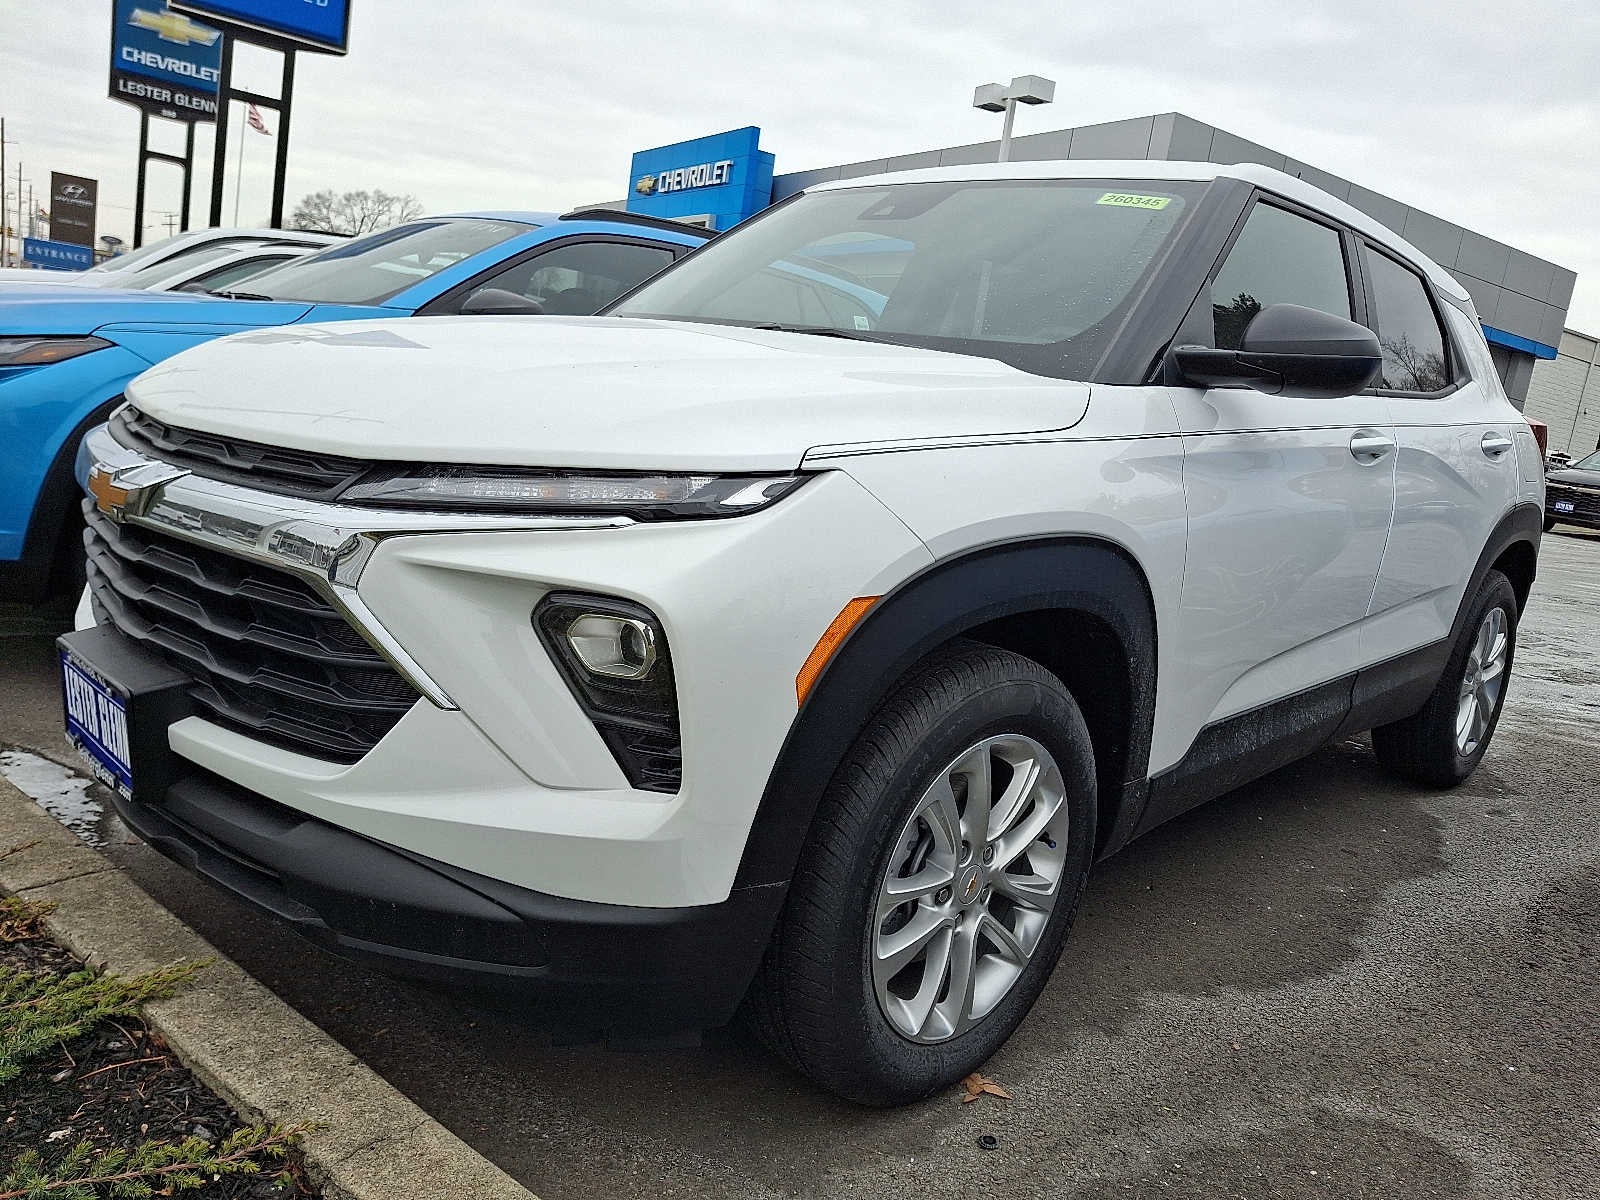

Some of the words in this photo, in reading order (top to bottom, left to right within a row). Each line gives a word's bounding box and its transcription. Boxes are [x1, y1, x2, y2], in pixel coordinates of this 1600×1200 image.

[122, 47, 220, 82] CHEVROLET
[119, 79, 172, 103] LESTER
[175, 94, 218, 113] GLENN
[658, 160, 734, 193] CHEVROLET
[1103, 194, 1162, 207] 260345
[27, 246, 89, 263] ENTRANCE
[63, 664, 99, 740] LESTER
[97, 692, 131, 770] GLENN
